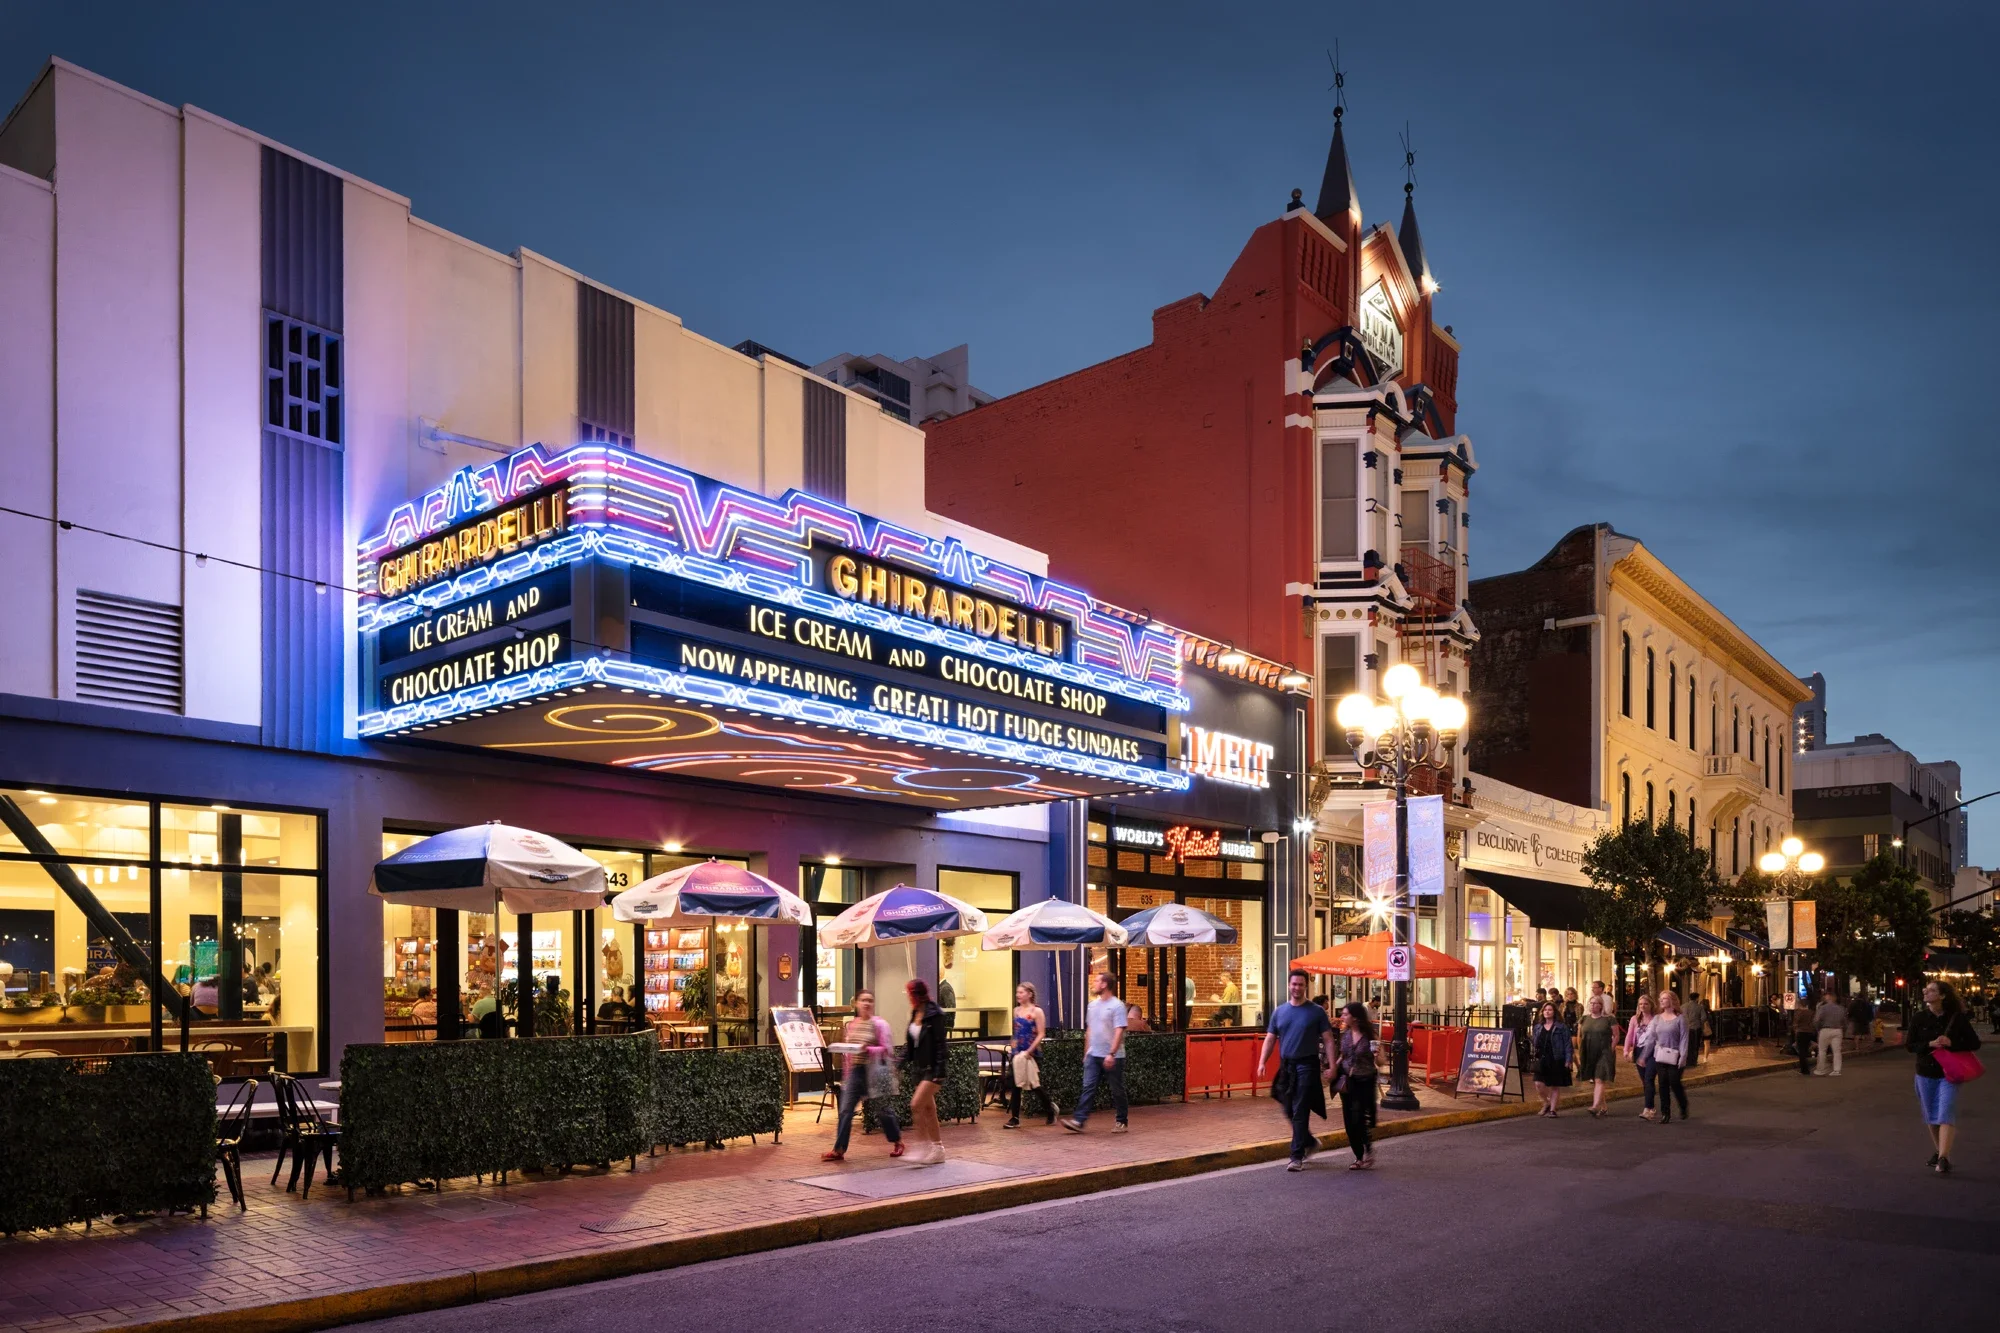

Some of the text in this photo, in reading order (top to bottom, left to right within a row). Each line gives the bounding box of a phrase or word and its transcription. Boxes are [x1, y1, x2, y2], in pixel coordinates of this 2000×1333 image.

[1363, 308, 1396, 349] YUMA
[379, 490, 567, 598] GHIRARDELLI
[409, 586, 540, 652] ICE CREAM AND
[826, 553, 1065, 658] GHIRARDELLI
[391, 651, 496, 705] CHOCOLATE
[503, 633, 560, 676] SHOP
[750, 604, 1107, 717] ICE CREAM AND CHOCOLATE SHOP
[681, 644, 735, 677] NOW
[740, 658, 858, 702] APPEARING:
[873, 684, 949, 724] GREAT!
[957, 703, 999, 733] HOT
[1004, 714, 1063, 747] FUDGE
[1067, 728, 1140, 763] SUNDAES
[1188, 726, 1274, 789] MELT
[1816, 785, 1882, 799] HOSTEL
[1115, 826, 1164, 847] WORLD'S
[1221, 841, 1256, 859] BURGER
[1476, 831, 1528, 855] EXCLUSIVE
[694, 884, 763, 893] GHIRARDELLI
[1140, 895, 1153, 905] 635
[885, 904, 944, 917] GHIRARDELLI
[1474, 1033, 1503, 1043] OPEN
